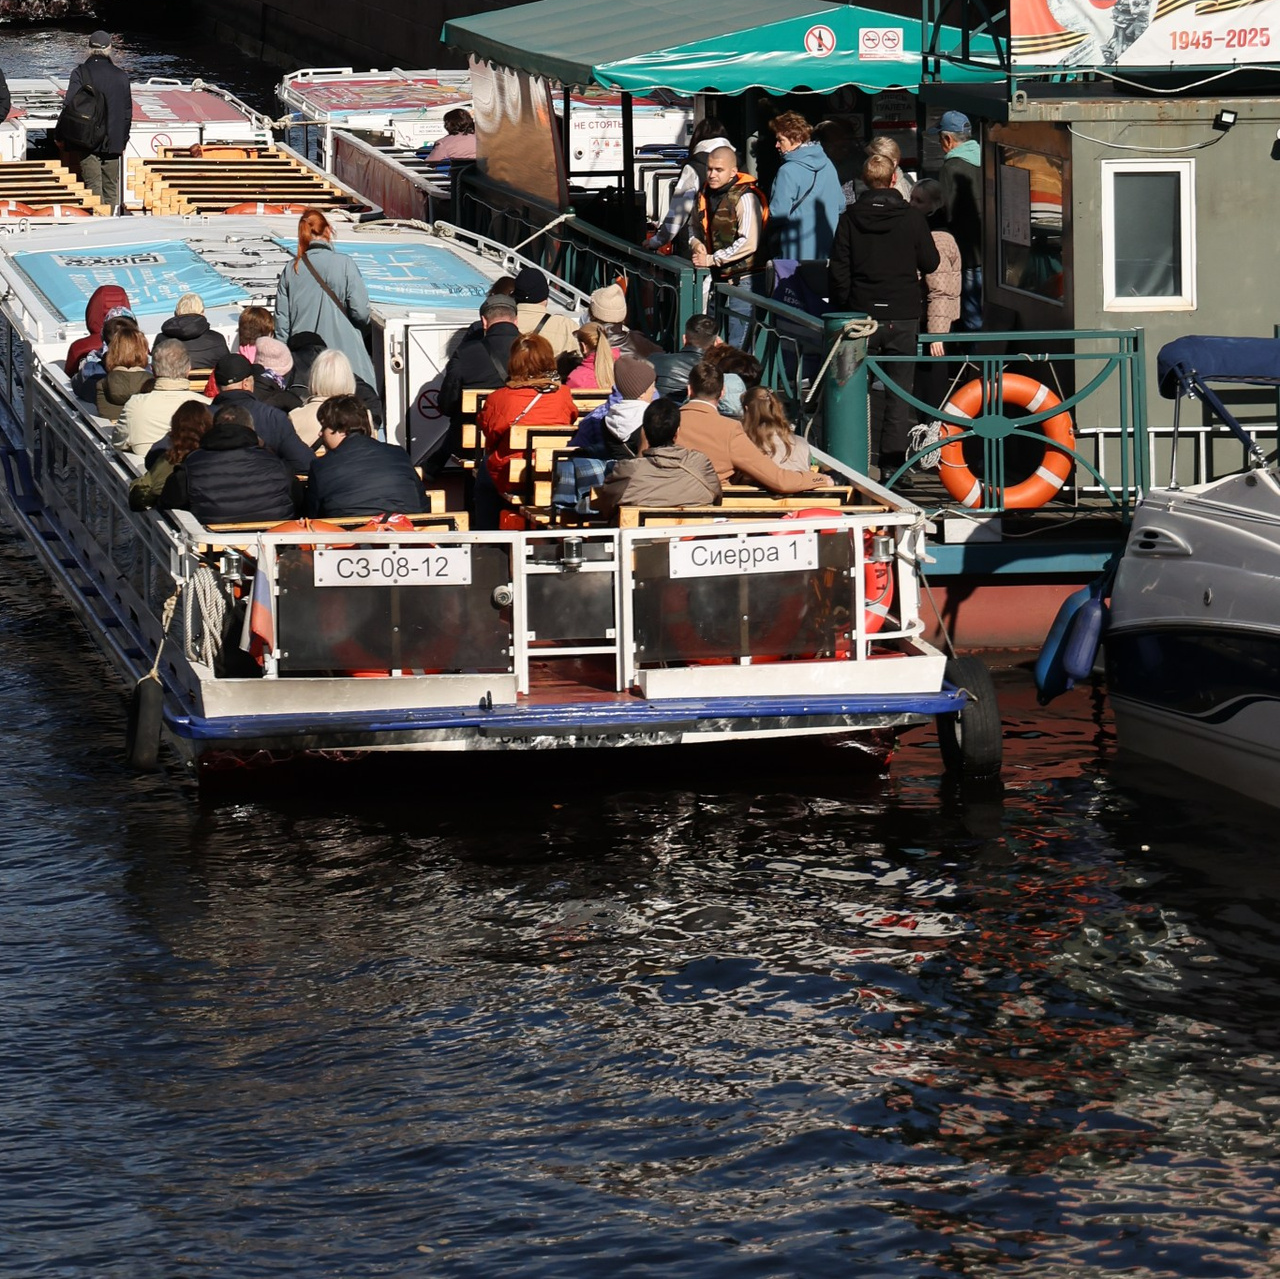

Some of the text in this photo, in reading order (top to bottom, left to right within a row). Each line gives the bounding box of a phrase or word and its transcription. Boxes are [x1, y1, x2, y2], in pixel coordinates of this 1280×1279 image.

[876, 103, 912, 111] ТУАЛЕТА
[574, 122, 586, 130] НЕ
[690, 540, 798, 569] Сиерра 1
